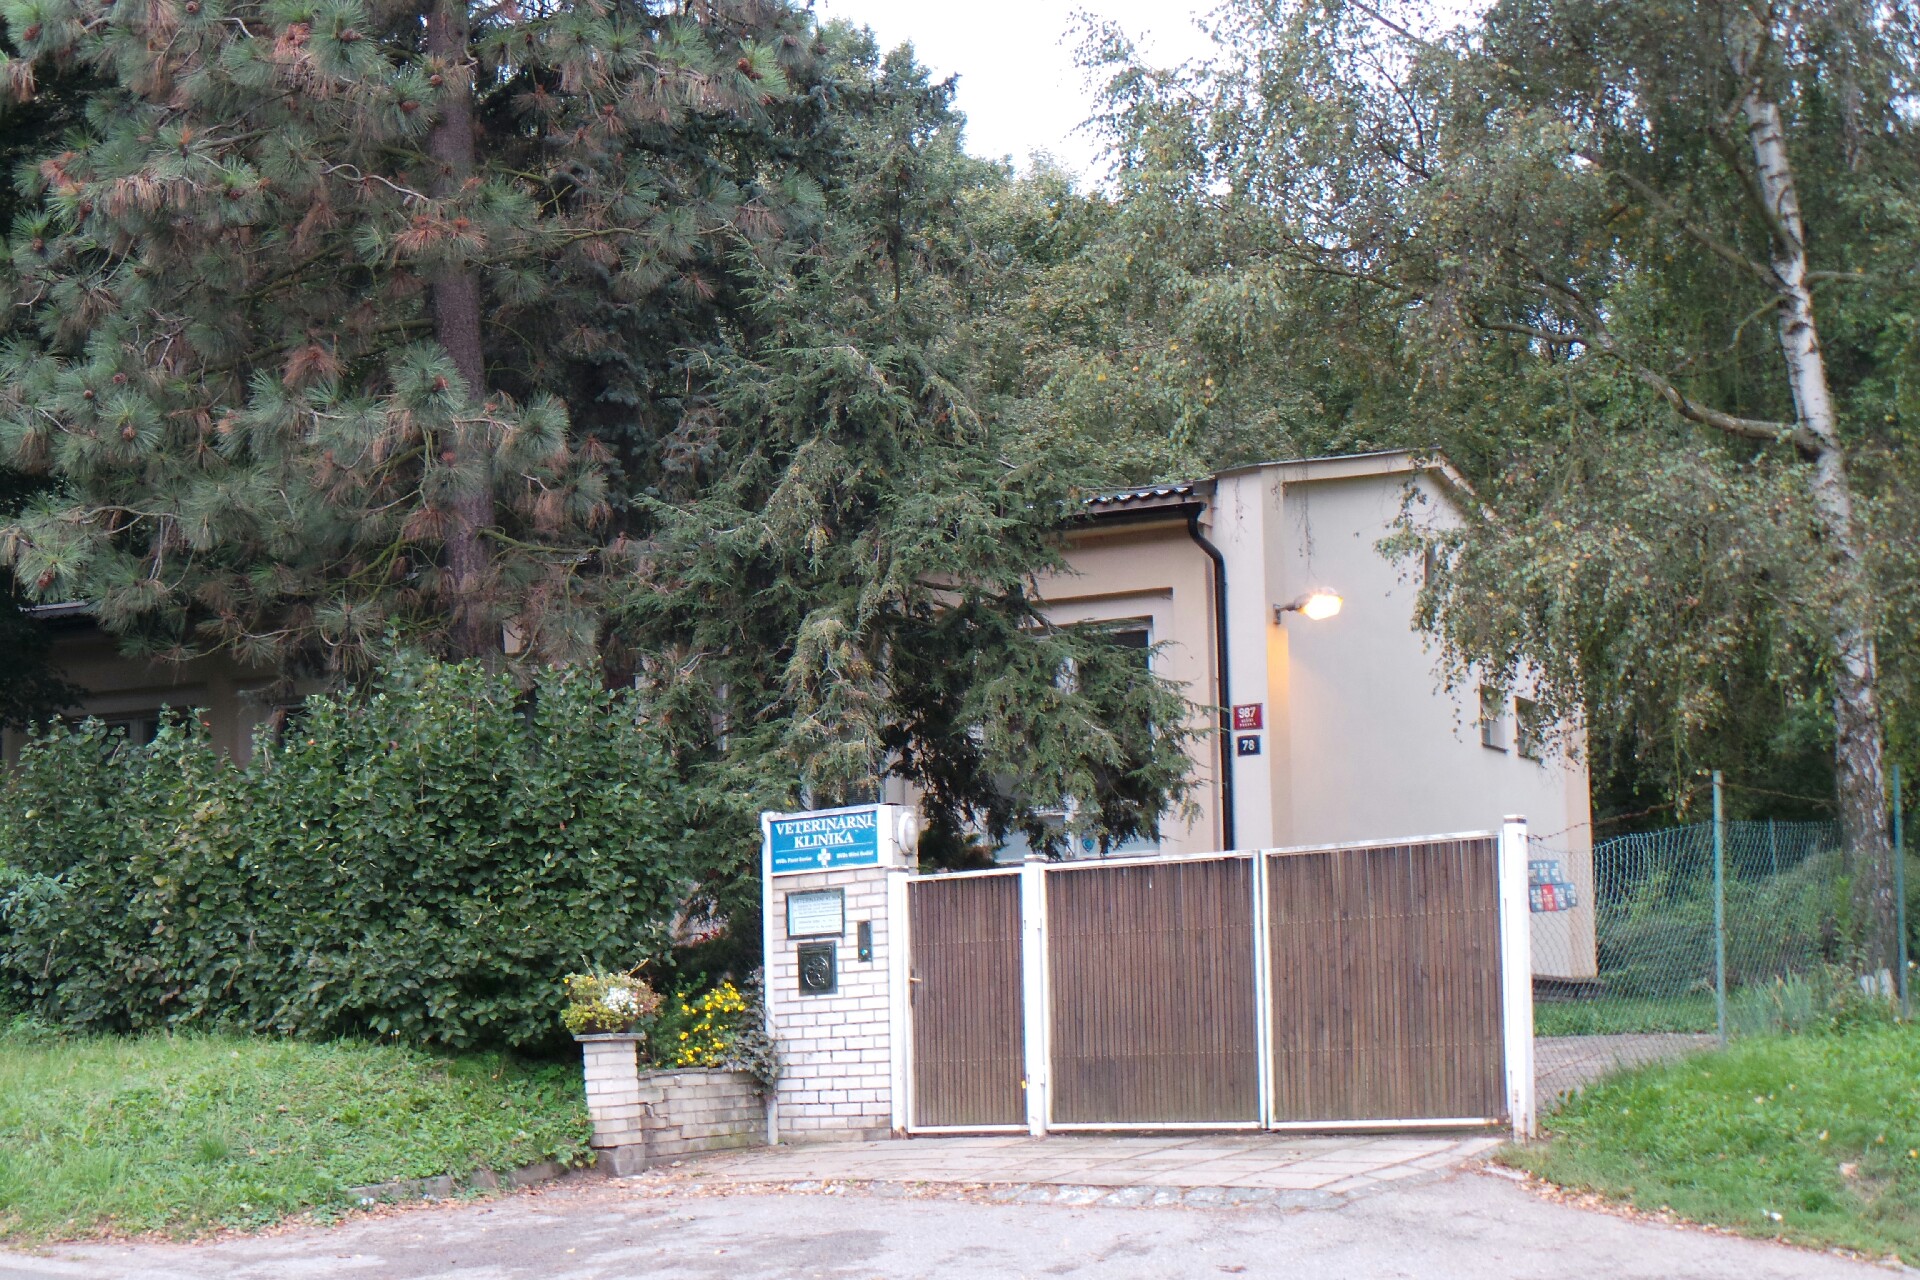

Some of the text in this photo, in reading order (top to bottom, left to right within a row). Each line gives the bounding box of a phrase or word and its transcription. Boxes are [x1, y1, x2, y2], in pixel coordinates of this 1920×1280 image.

[1238, 707, 1256, 718] 987
[1242, 739, 1255, 751] 78
[775, 812, 876, 835] VETERINÁRNÍ
[794, 832, 854, 848] KLINIKA
